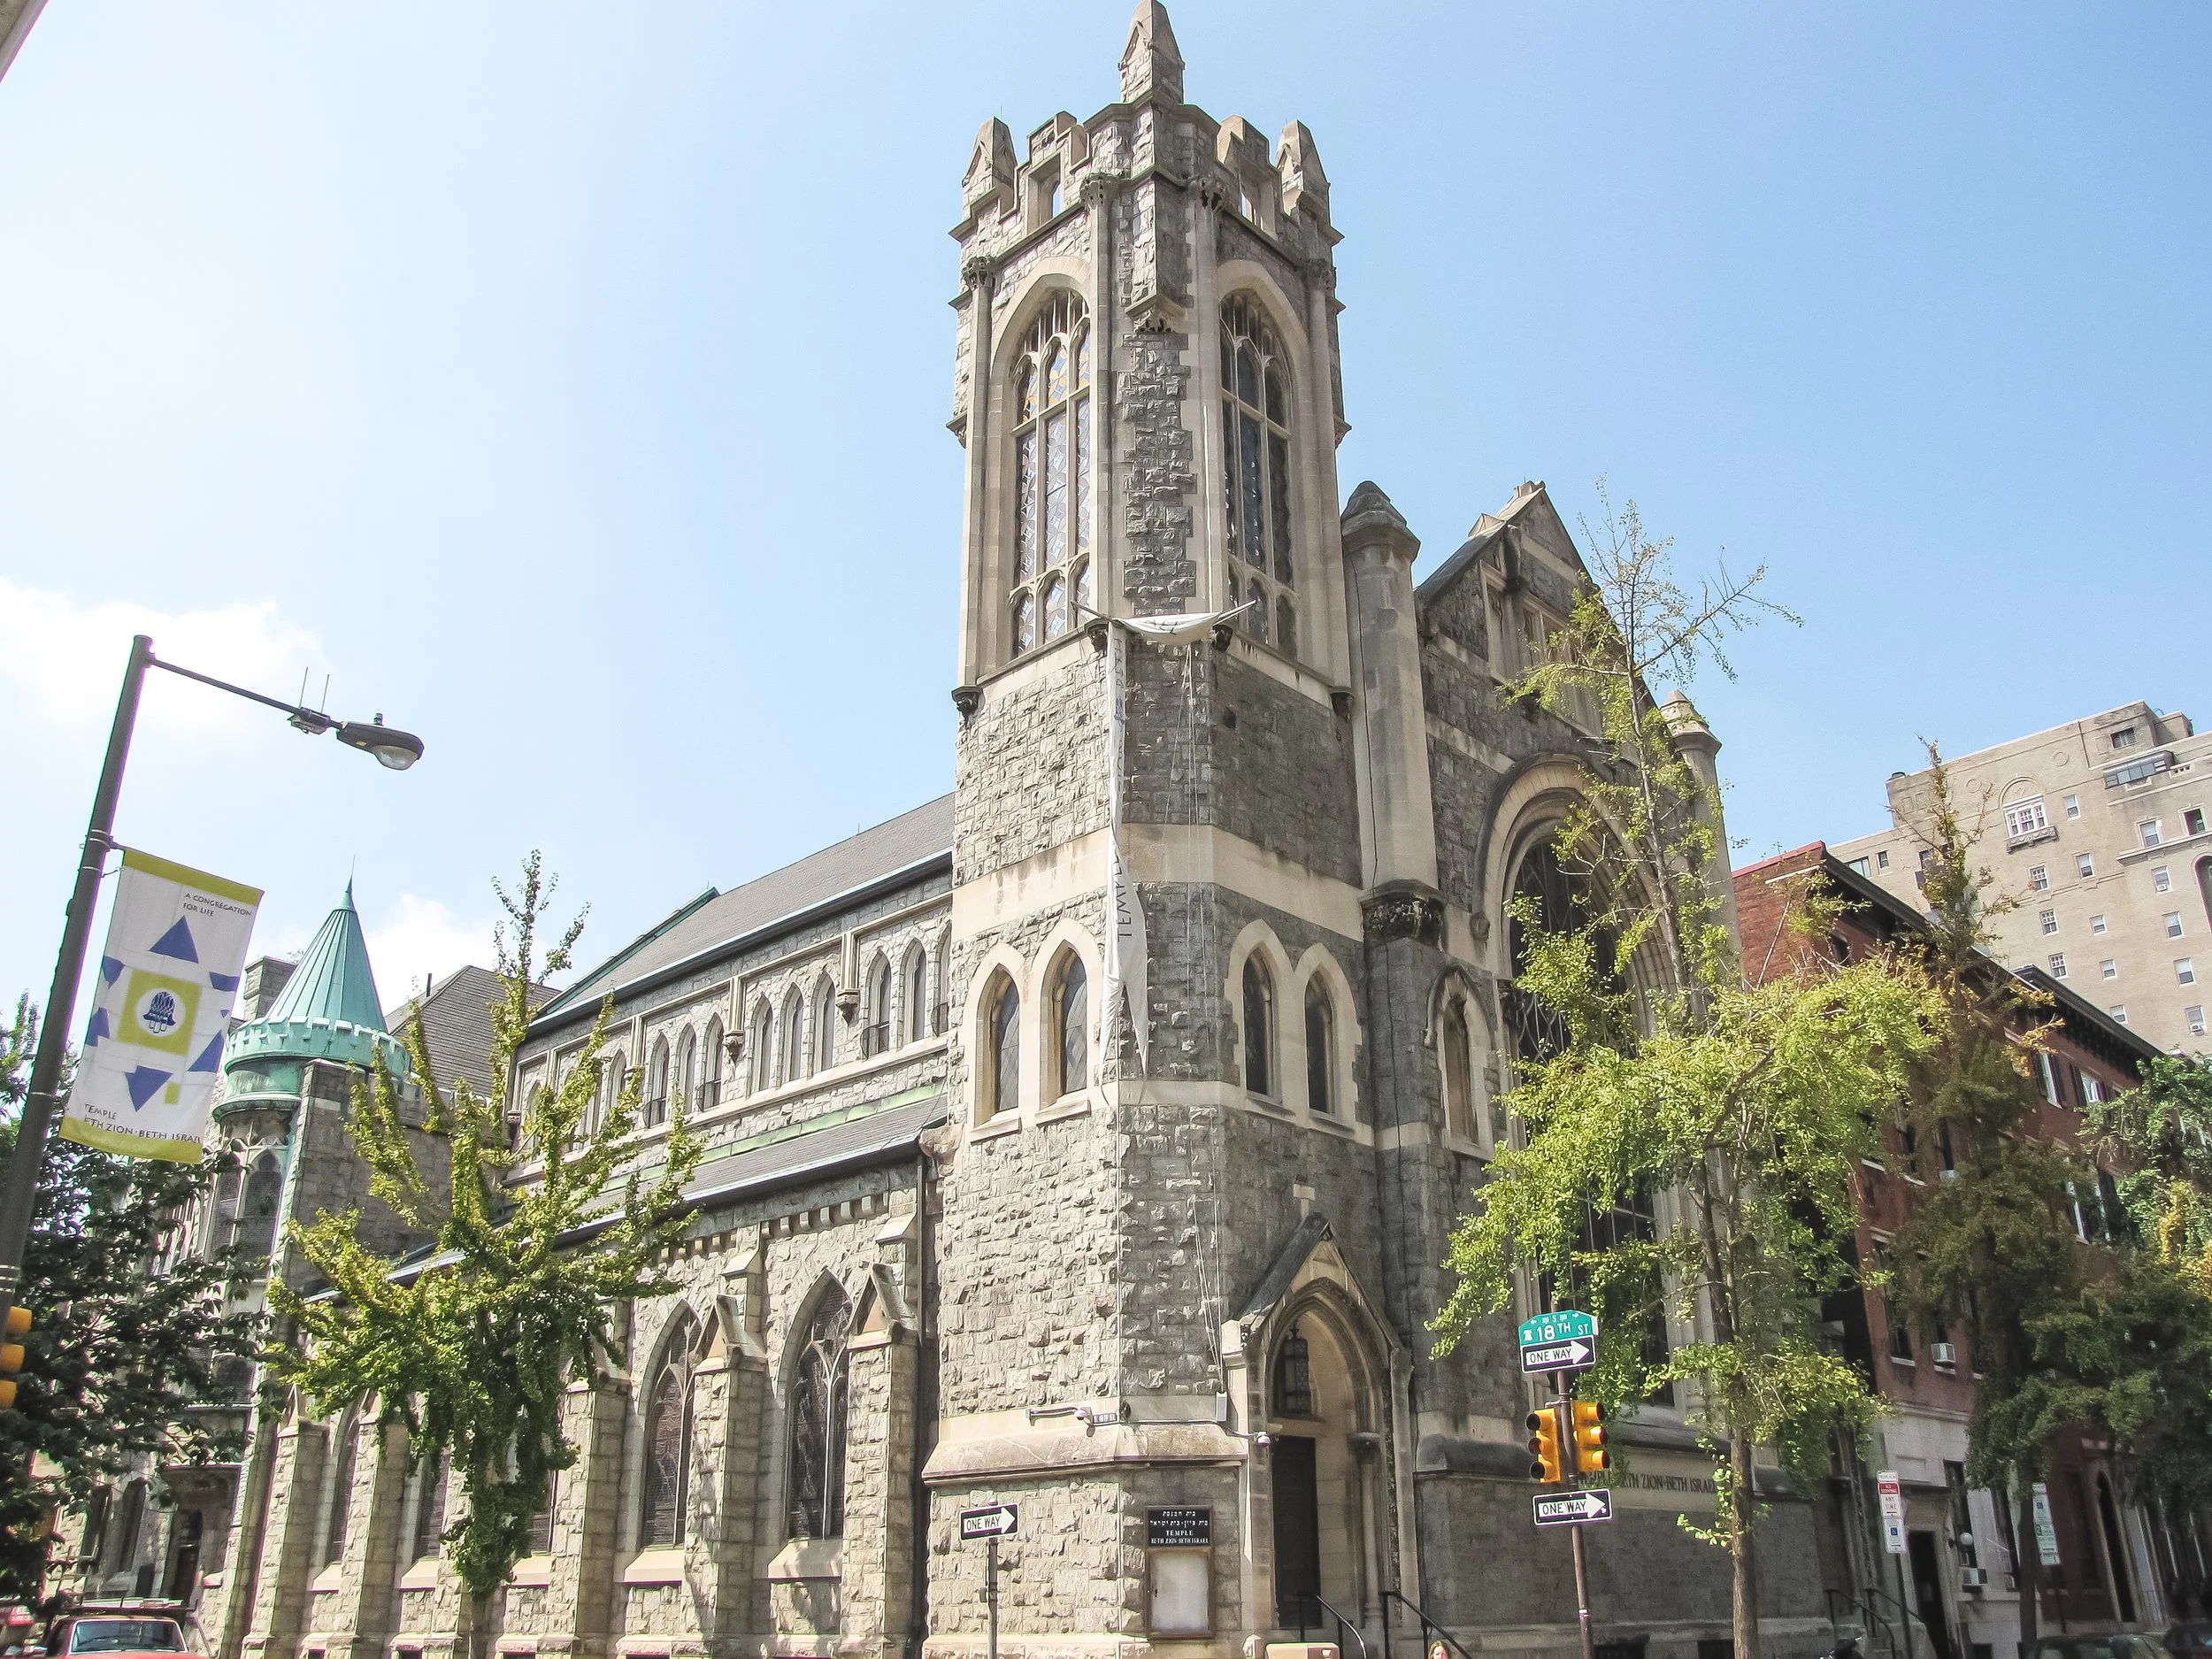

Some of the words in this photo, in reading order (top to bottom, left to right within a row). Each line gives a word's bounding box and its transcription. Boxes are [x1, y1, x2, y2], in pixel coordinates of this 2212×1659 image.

[183, 902, 198, 912] FOR
[200, 907, 214, 918] LIFE
[193, 895, 252, 917] CONGREGATION
[85, 1103, 117, 1120] TEMPLE
[84, 1117, 104, 1130] ETH
[1577, 1324, 1589, 1335] ST
[1530, 1351, 1550, 1363] ONE
[1552, 1348, 1572, 1360] WAY
[1542, 1502, 1564, 1515] ONE
[1565, 1501, 1586, 1513] WAY
[966, 1518, 982, 1531] ONE
[984, 1515, 1001, 1529] WAY
